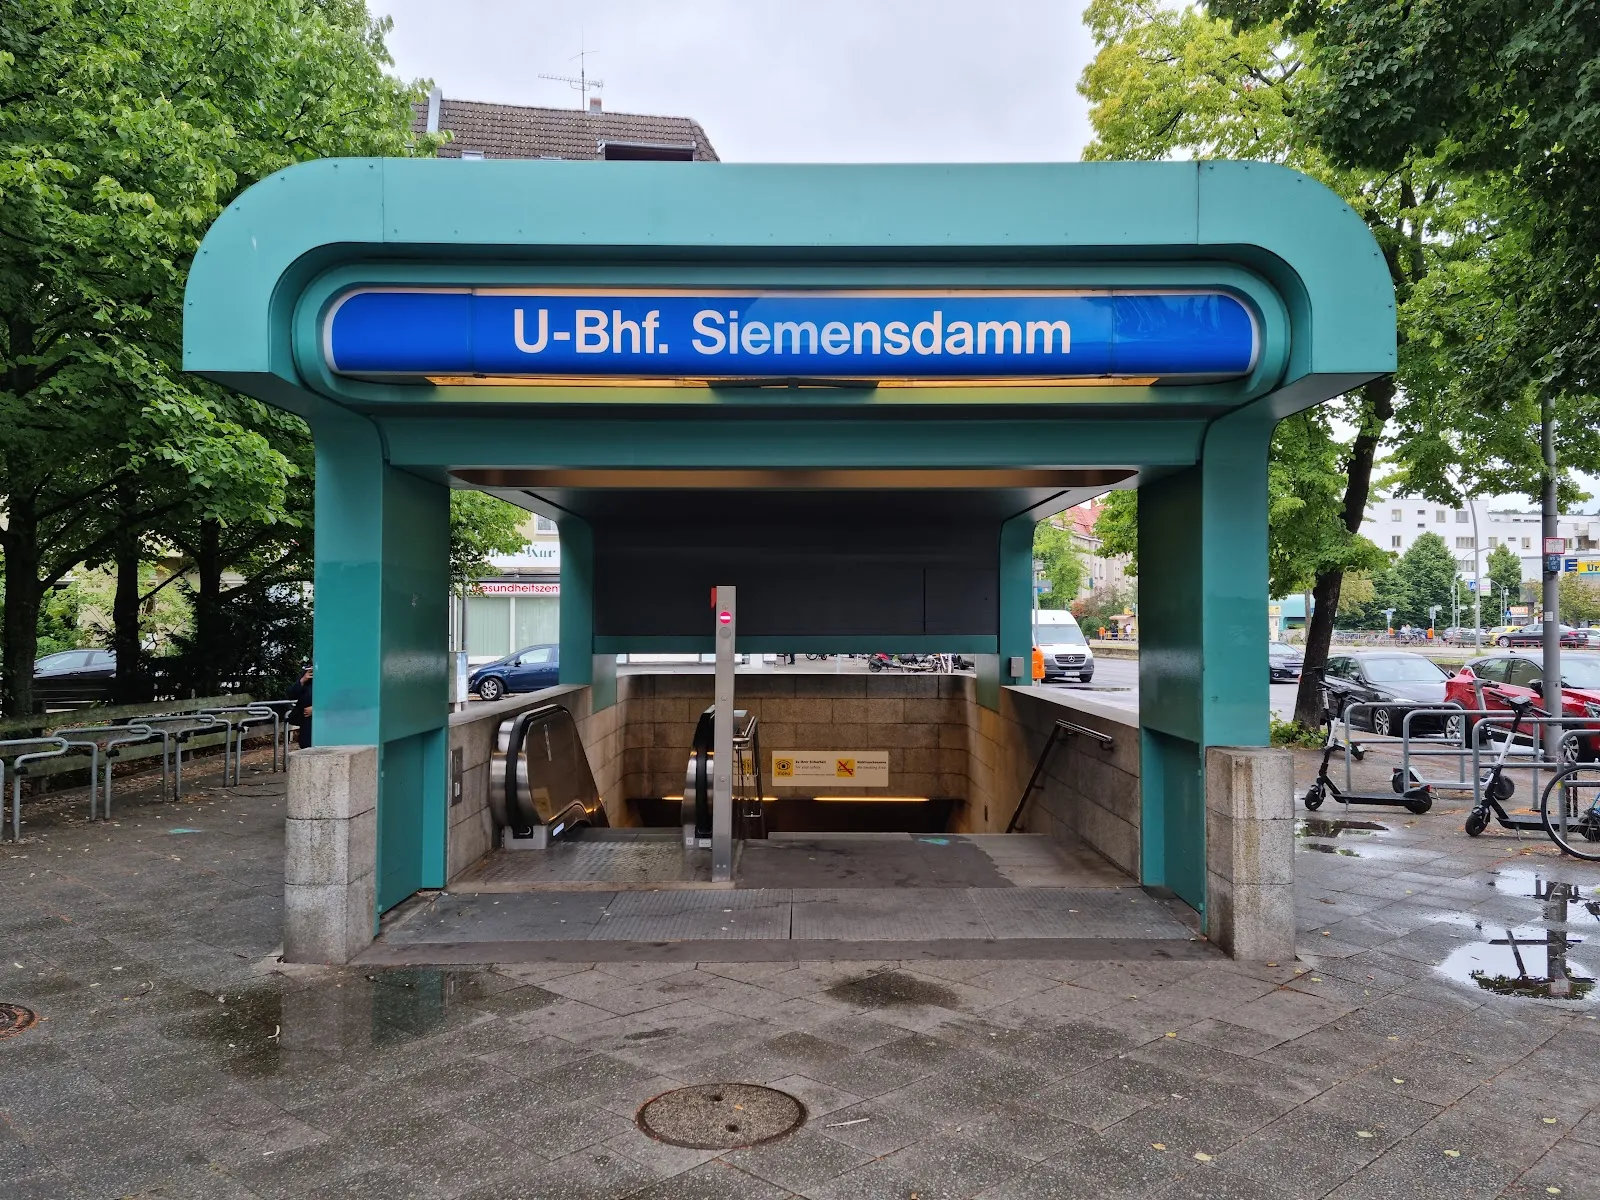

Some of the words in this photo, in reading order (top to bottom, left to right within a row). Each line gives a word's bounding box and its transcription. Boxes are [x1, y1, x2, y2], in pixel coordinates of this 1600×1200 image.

[514, 308, 669, 354] U-Bhf.
[691, 309, 1071, 355] Siemensdamm
[472, 584, 560, 593] Gesundheitszen
